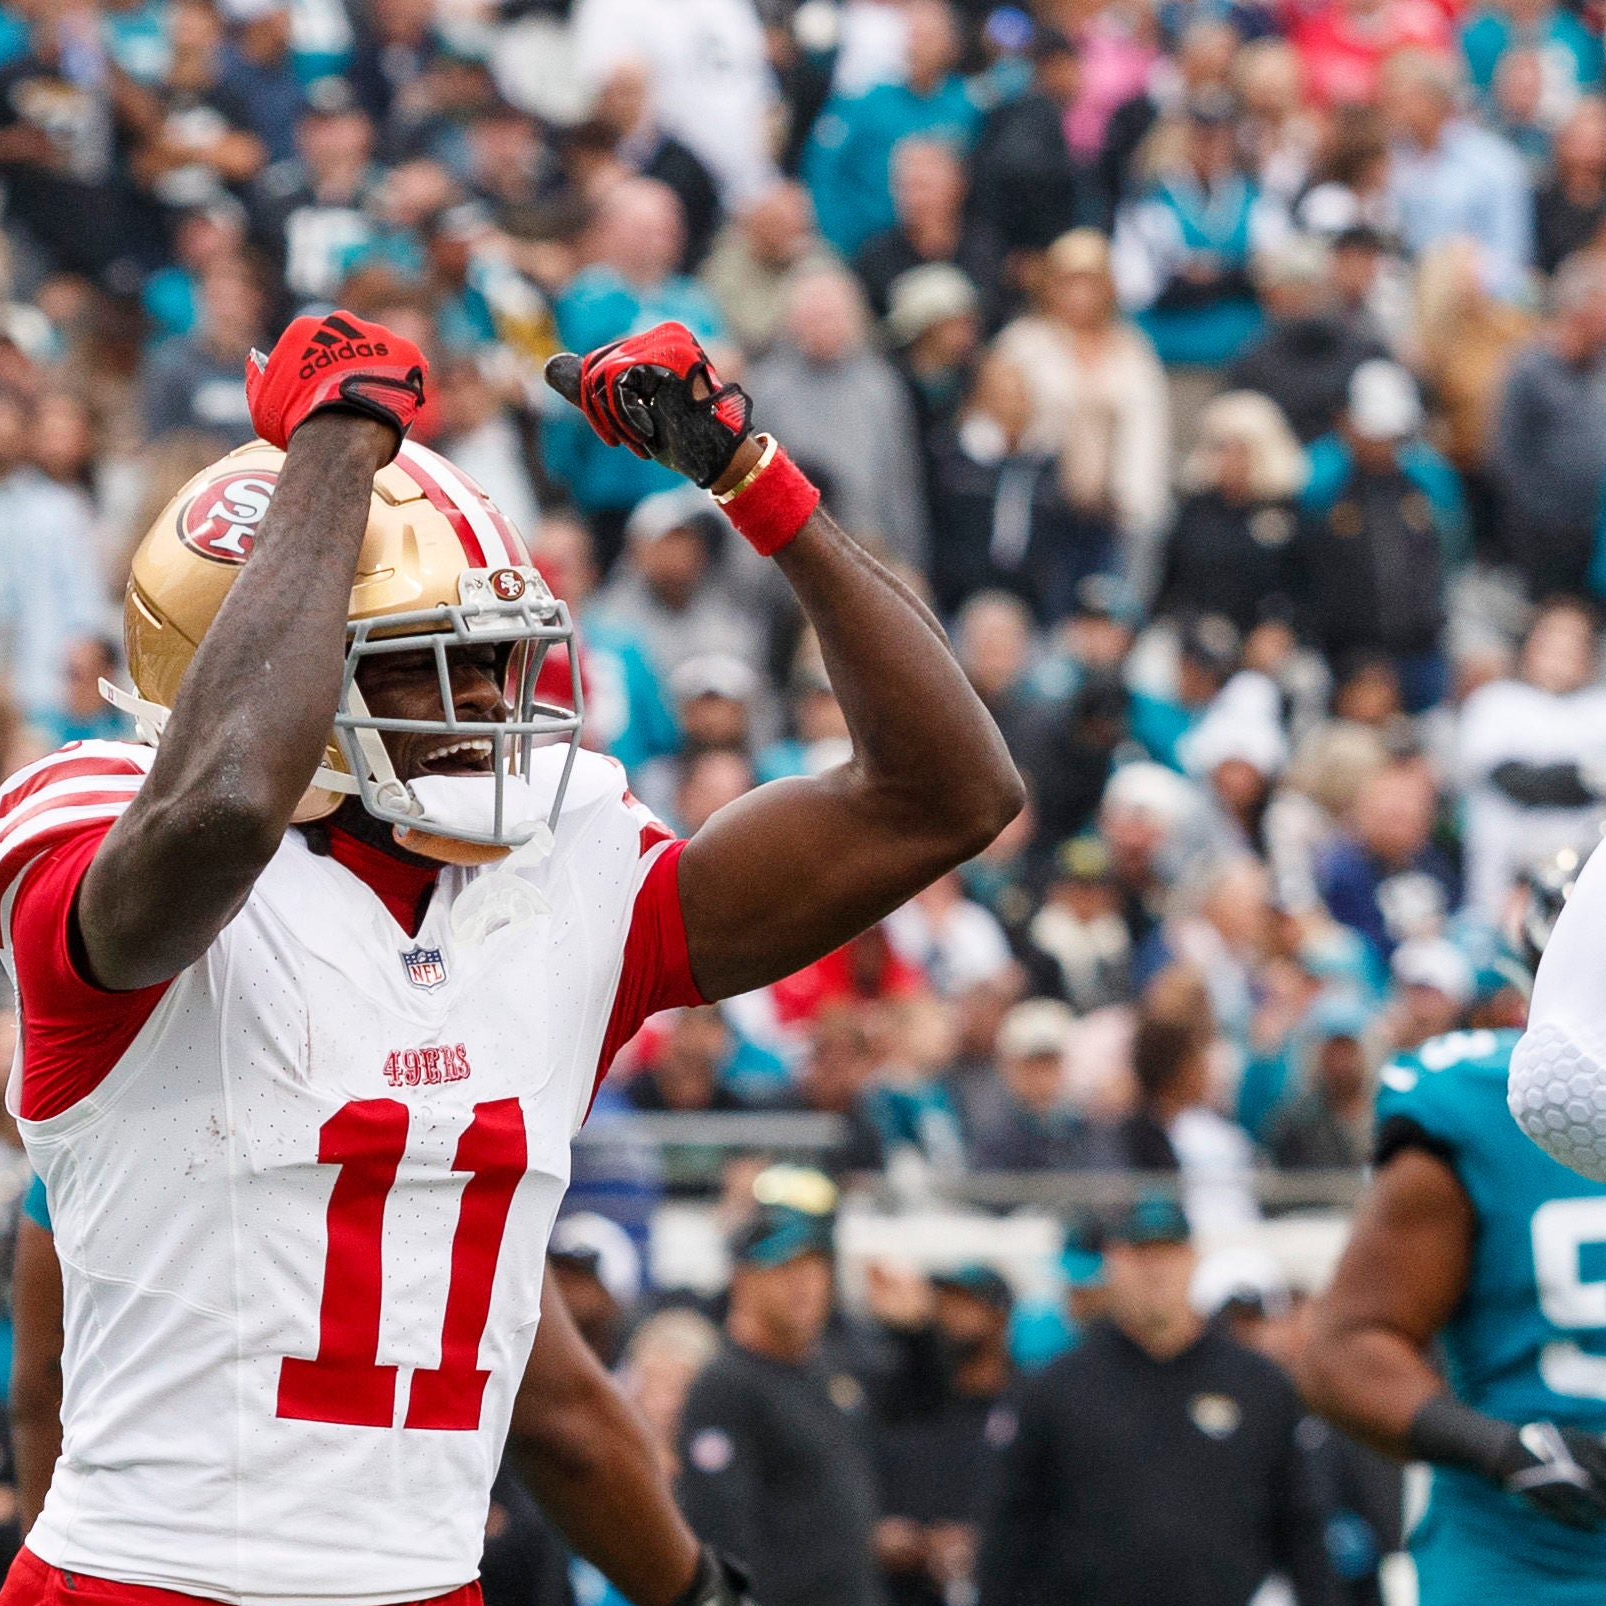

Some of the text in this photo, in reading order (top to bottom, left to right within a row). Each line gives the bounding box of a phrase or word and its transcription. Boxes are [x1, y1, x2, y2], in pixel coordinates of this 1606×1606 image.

[299, 340, 389, 381] adidas
[411, 963, 442, 983] NFL
[383, 1043, 471, 1087] 49ERS
[276, 1097, 527, 1430] 11
